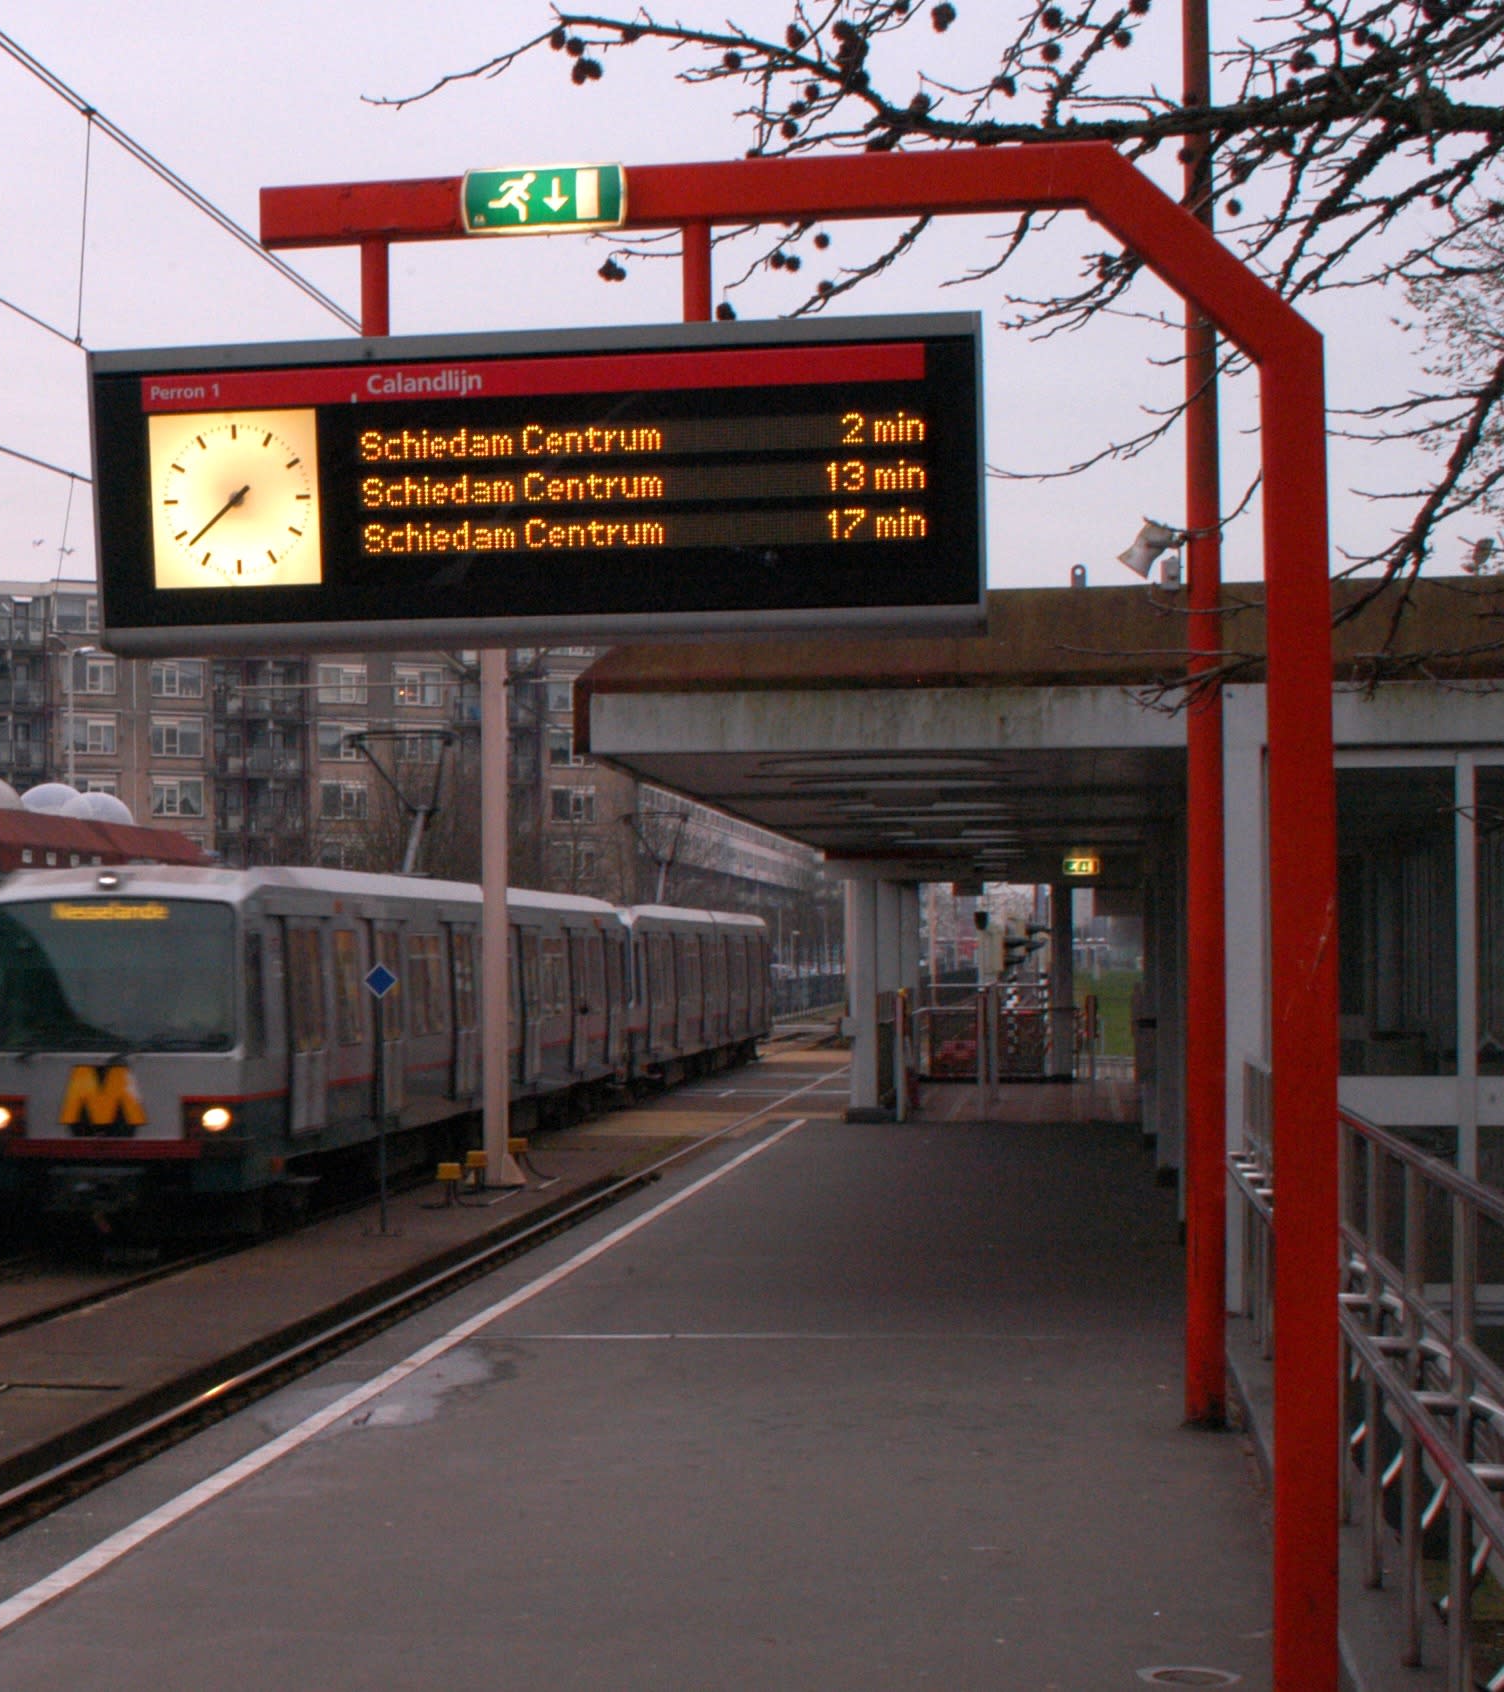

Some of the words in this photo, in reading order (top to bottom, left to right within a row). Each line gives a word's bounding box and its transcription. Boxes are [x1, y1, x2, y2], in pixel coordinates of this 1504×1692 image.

[149, 385, 205, 401] Perron
[211, 383, 221, 397] 1
[366, 370, 483, 396] Calandlijn
[361, 428, 513, 460] Schiedam
[522, 425, 662, 454] Centrum
[841, 412, 864, 443] 2
[874, 411, 925, 442] min
[362, 474, 515, 506] Schiedam
[524, 472, 664, 501] Centrum
[826, 461, 865, 491] 13
[875, 459, 925, 490] min
[364, 520, 516, 552] Schiedam
[525, 518, 664, 547] Centrum
[827, 508, 866, 539] 17
[876, 507, 927, 538] min
[59, 1066, 147, 1125] M
